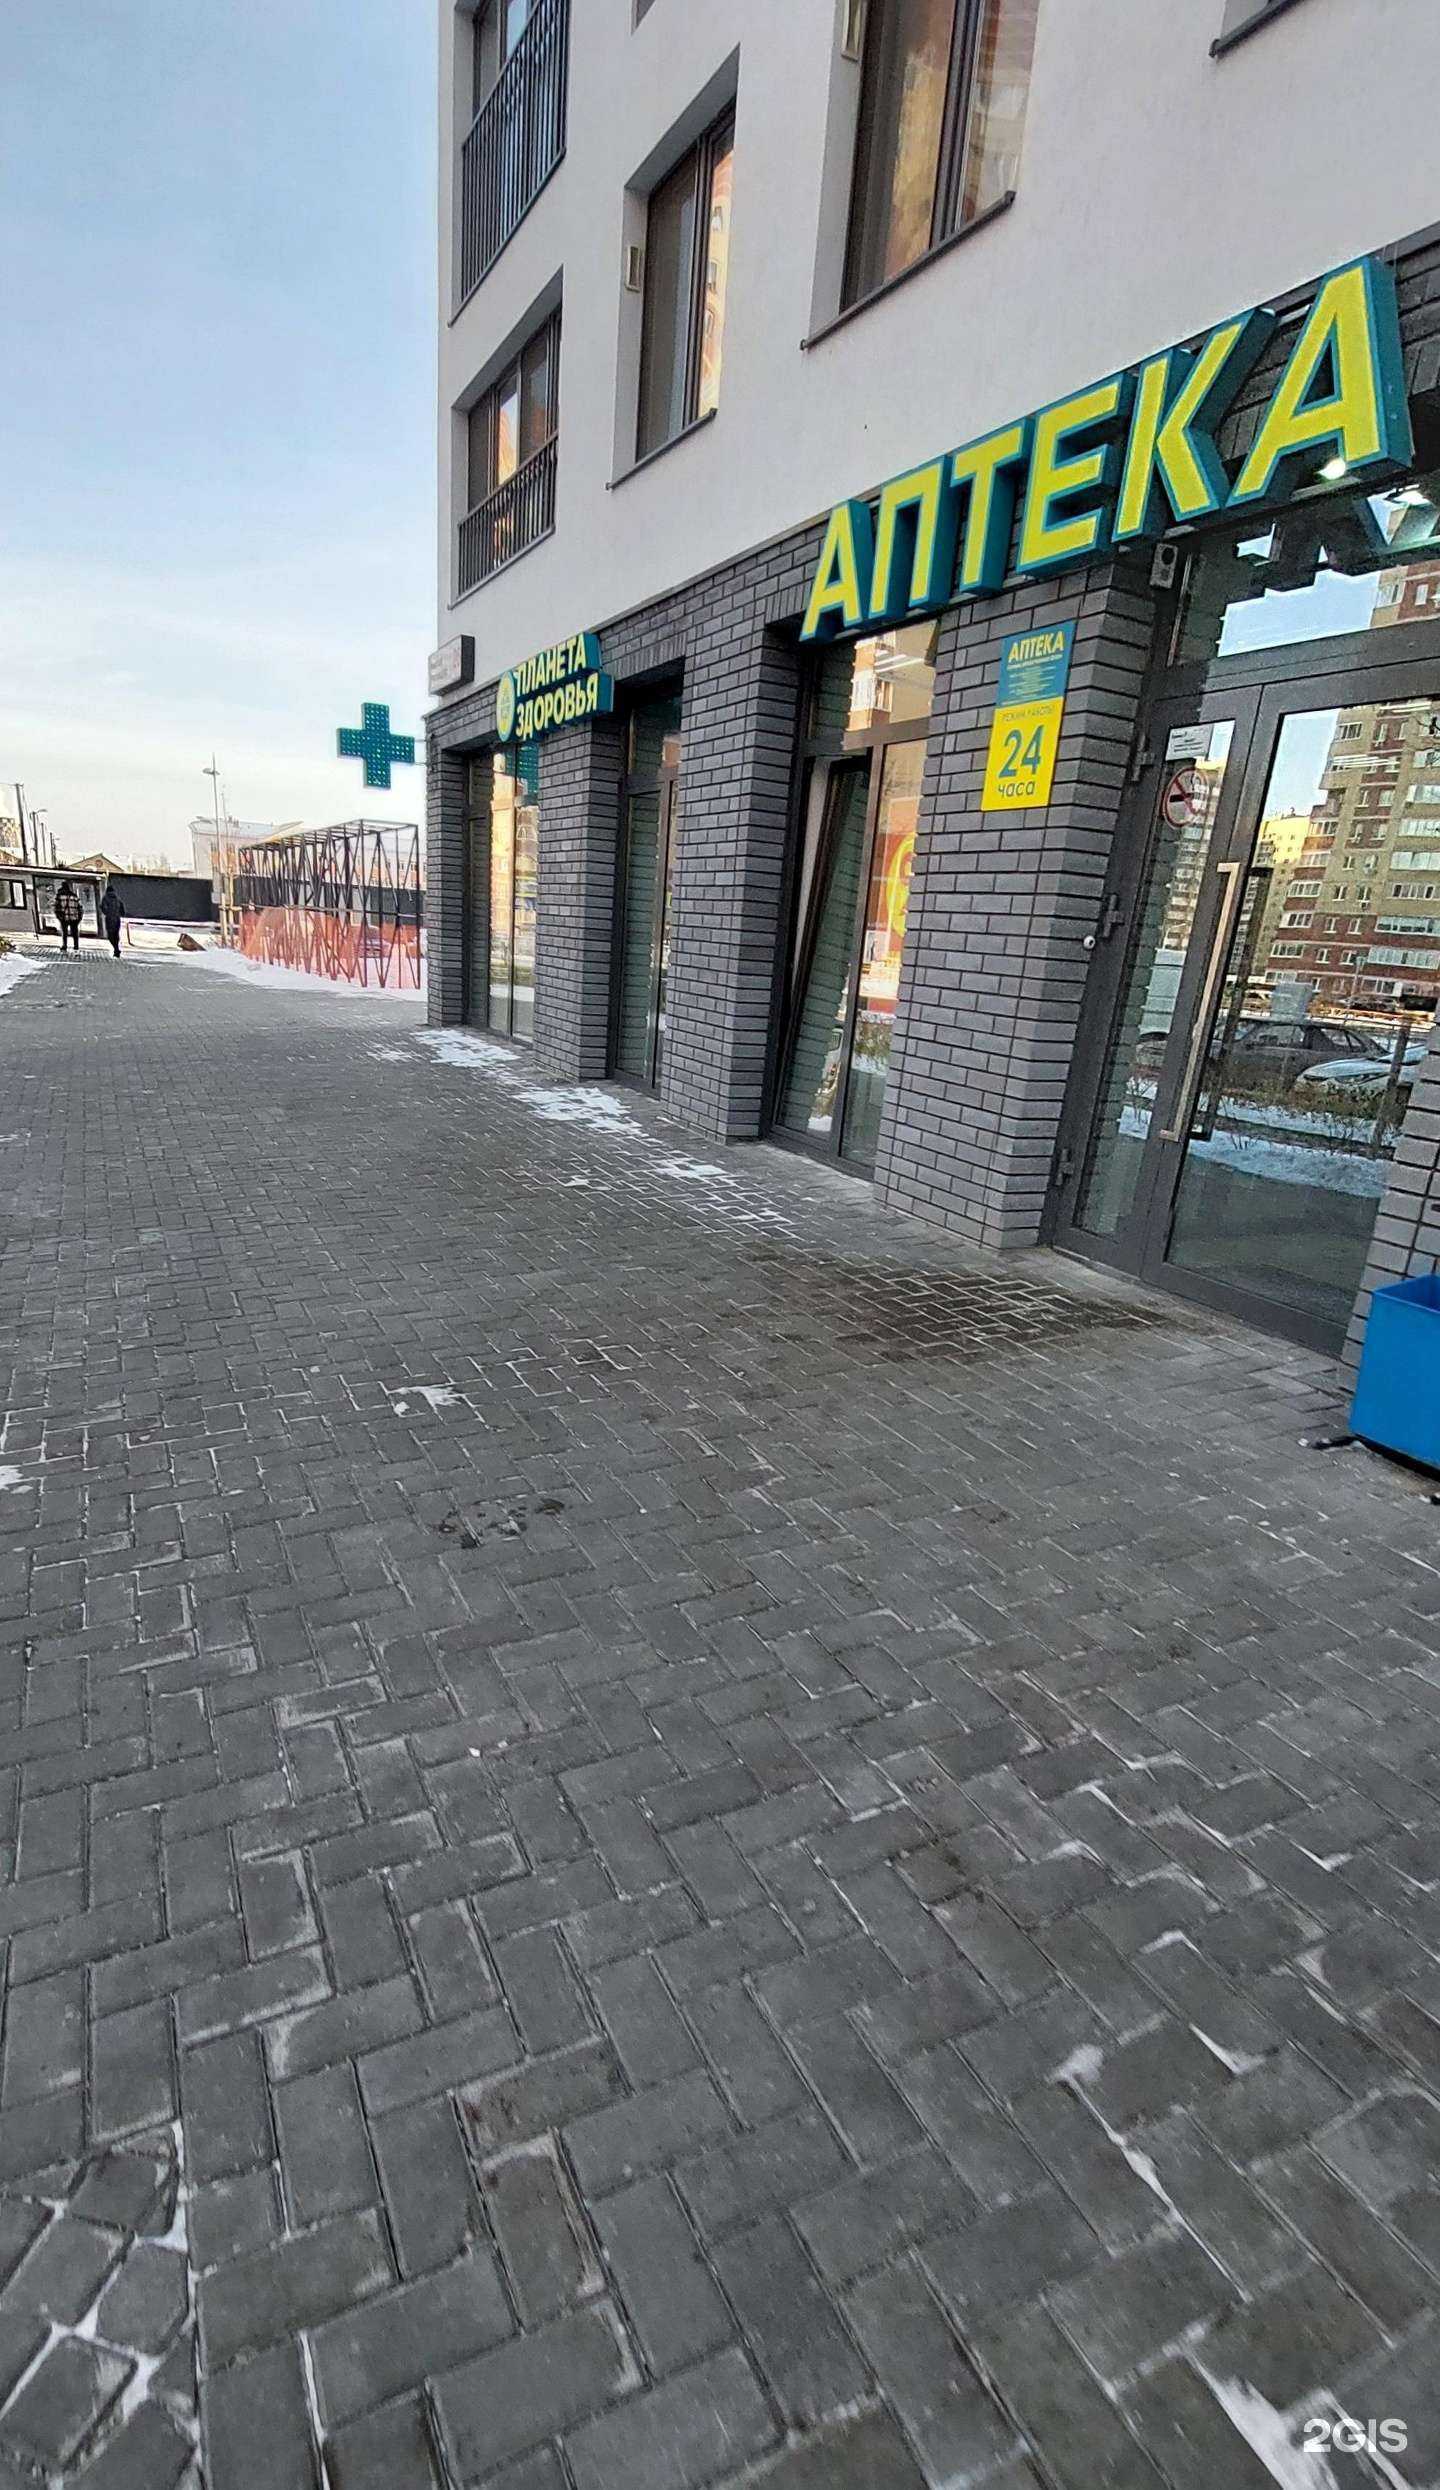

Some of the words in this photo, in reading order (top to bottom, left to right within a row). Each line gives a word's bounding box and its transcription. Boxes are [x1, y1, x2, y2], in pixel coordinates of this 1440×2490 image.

[800, 254, 1392, 642] АПТЕКА
[513, 633, 587, 697] ПЛАНЕТА
[1008, 630, 1065, 663] АПТЕКА
[516, 672, 598, 741] ЗДОРОВЬЯ
[998, 725, 1045, 779] 24
